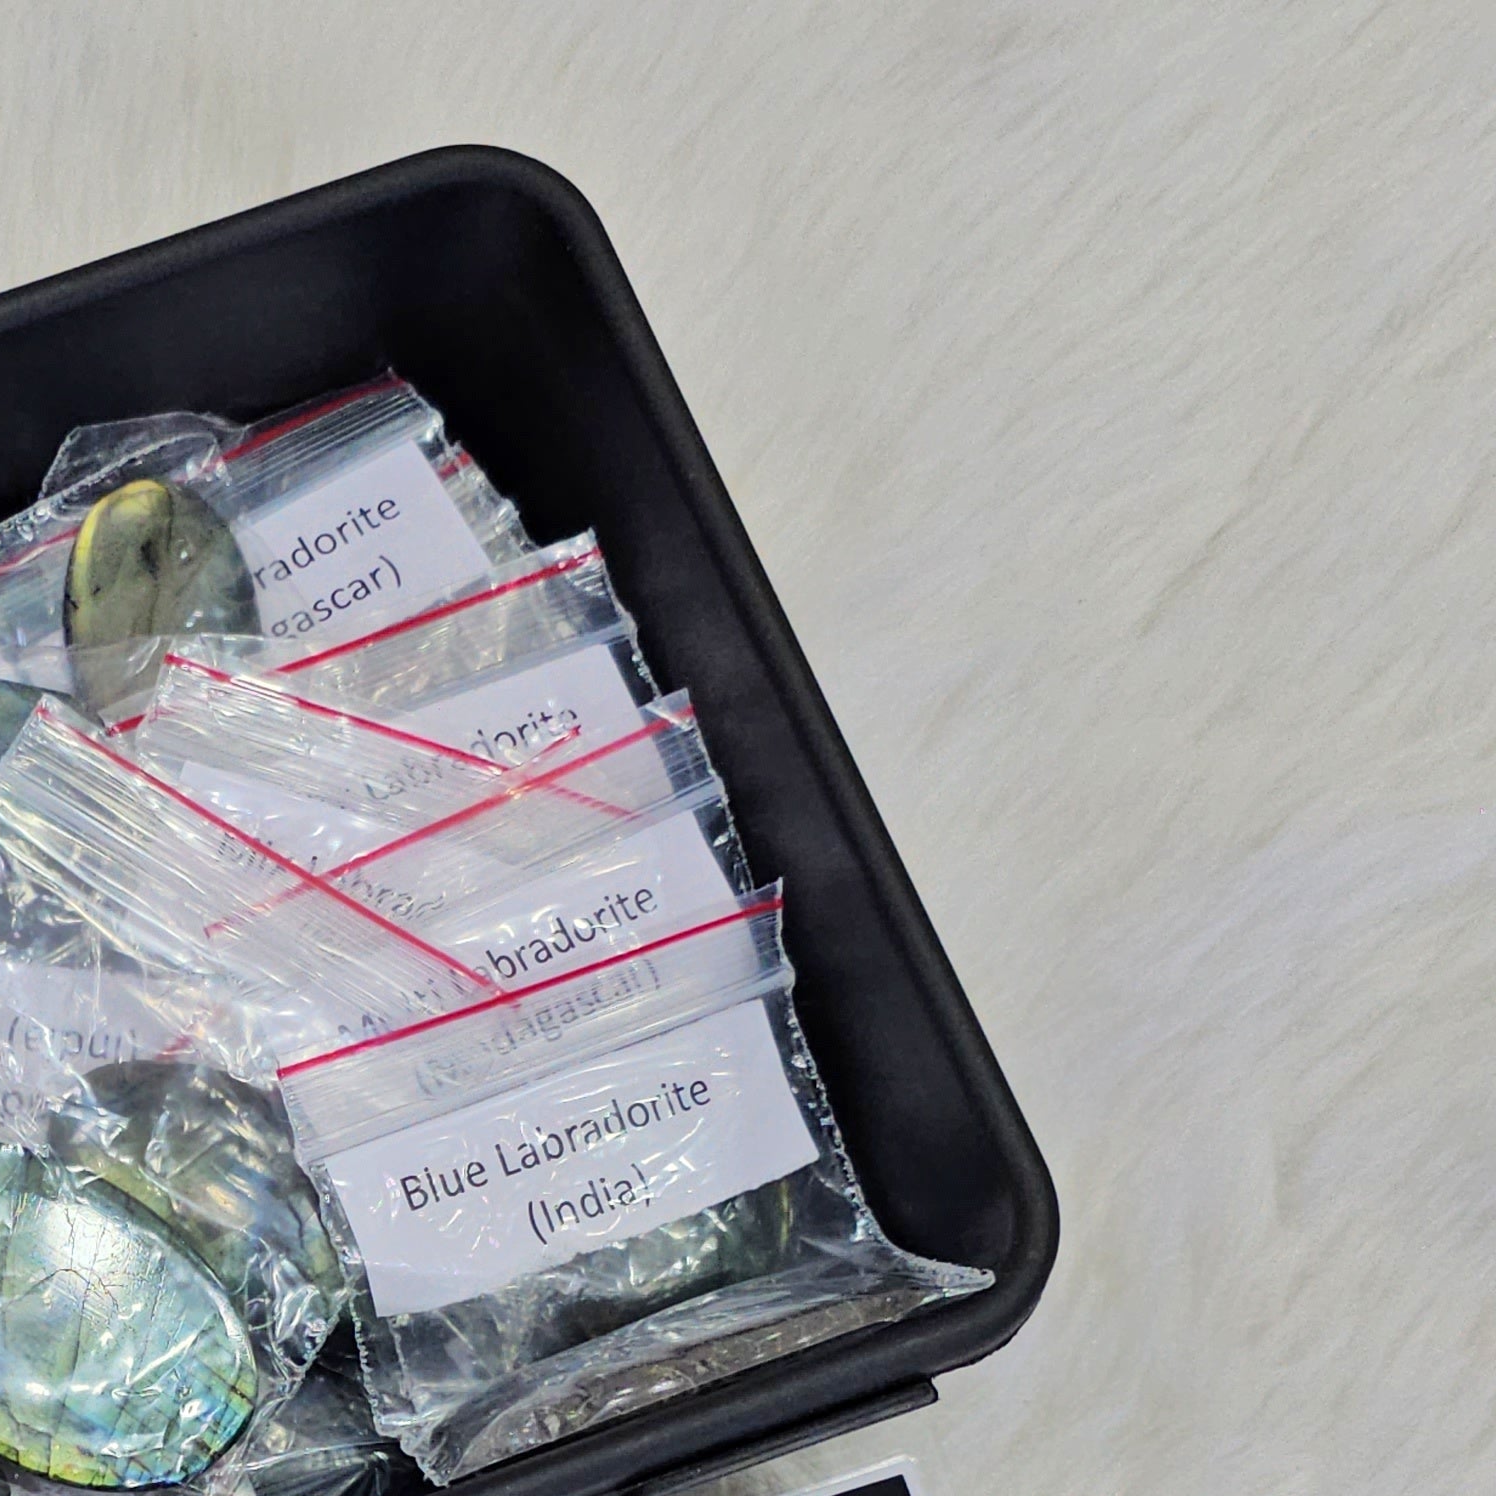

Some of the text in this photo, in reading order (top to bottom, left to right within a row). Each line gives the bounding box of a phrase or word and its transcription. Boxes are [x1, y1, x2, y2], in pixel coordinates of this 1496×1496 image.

[399, 1079, 711, 1211] Blue Labradorite
[527, 1163, 652, 1245] (India)
